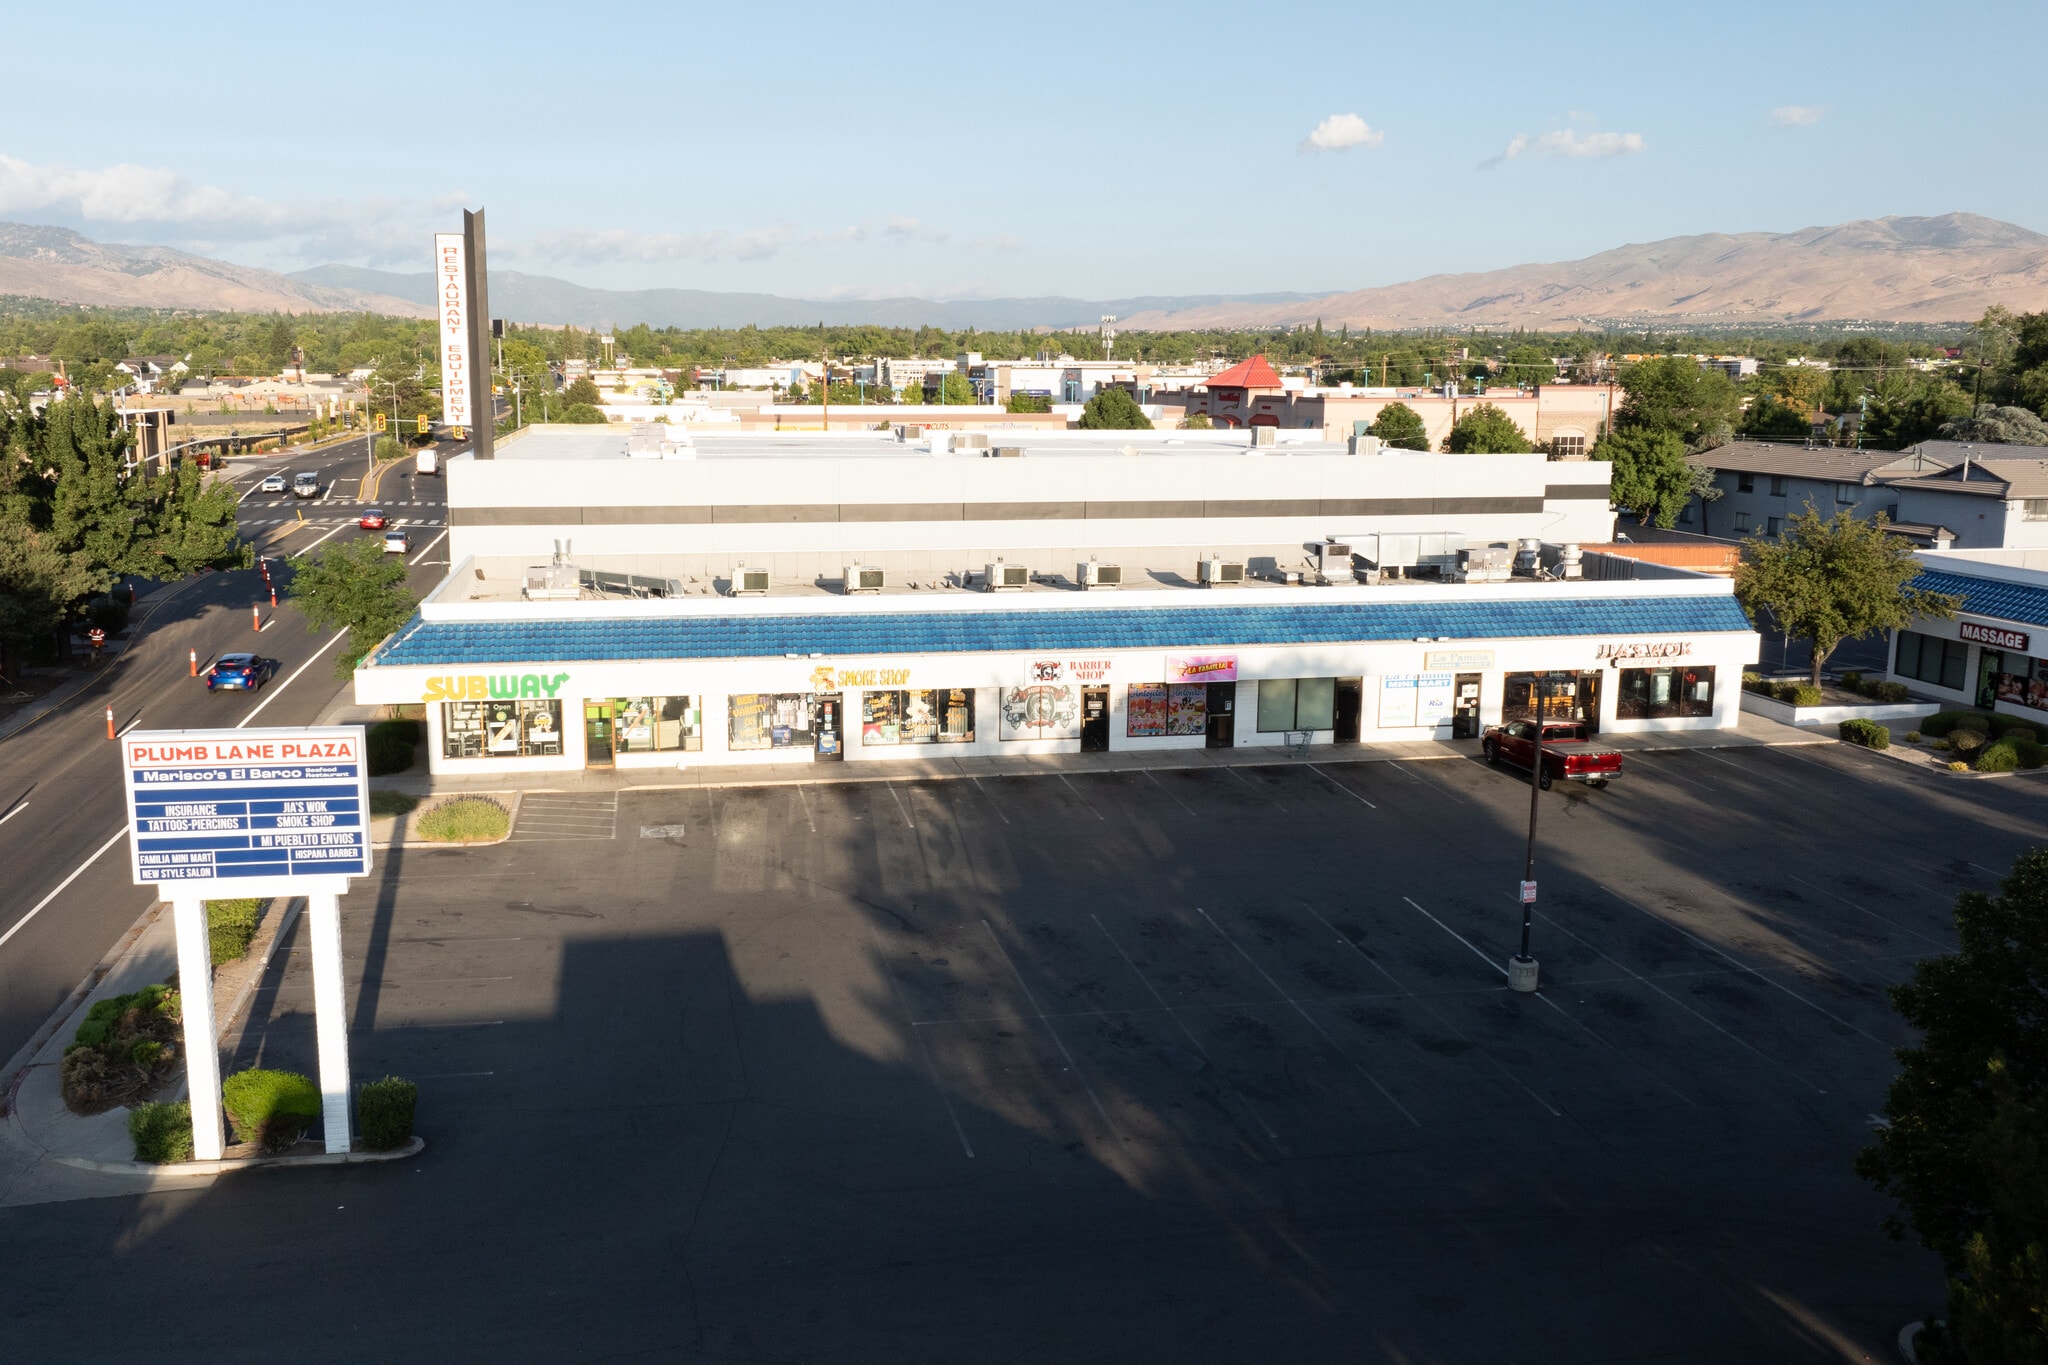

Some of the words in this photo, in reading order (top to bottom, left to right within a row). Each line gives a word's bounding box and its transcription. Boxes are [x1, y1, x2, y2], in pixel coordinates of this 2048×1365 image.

[443, 247, 461, 334] RESTAURANT
[448, 345, 464, 422] EQUIPMENT
[1961, 624, 2024, 649] MASSAGE
[1069, 660, 1112, 671] BARBER
[1187, 666, 1197, 674] LA
[1198, 661, 1227, 673] FAMILIA
[838, 669, 878, 687] SMOKE
[879, 668, 911, 686] SHOP
[1076, 670, 1105, 680] SHOP
[420, 672, 570, 702] SUBWAY
[1388, 680, 1414, 688] MINI
[1418, 679, 1450, 688] MART
[736, 693, 759, 706] BEST
[1428, 698, 1443, 707] Ria
[493, 703, 512, 711] Open
[731, 703, 767, 718] VARIETY
[133, 746, 209, 762] PLUMB
[215, 744, 275, 760] LANE
[281, 743, 352, 758] PLAZA
[143, 770, 227, 782] Marisco's
[231, 769, 246, 780] El
[250, 768, 302, 779] Barco
[165, 804, 218, 817] INSURANCE
[282, 801, 305, 813] JIA'S
[306, 801, 328, 813] WOK
[147, 818, 240, 832] TATTOOS-PIERCINGS
[276, 815, 309, 828] SMOKE
[311, 815, 336, 826] SHOP
[261, 835, 273, 847] MI
[274, 834, 319, 846] PUEBLITO
[320, 833, 355, 845] ENVIOS
[139, 853, 171, 865] FAMILIA
[171, 853, 189, 864] MINI
[190, 852, 213, 863] MART
[295, 849, 328, 859] HISPANA
[328, 848, 359, 858] BARBER
[142, 868, 160, 879] NEW
[160, 868, 185, 878] STYLE
[186, 867, 212, 877] SALON
